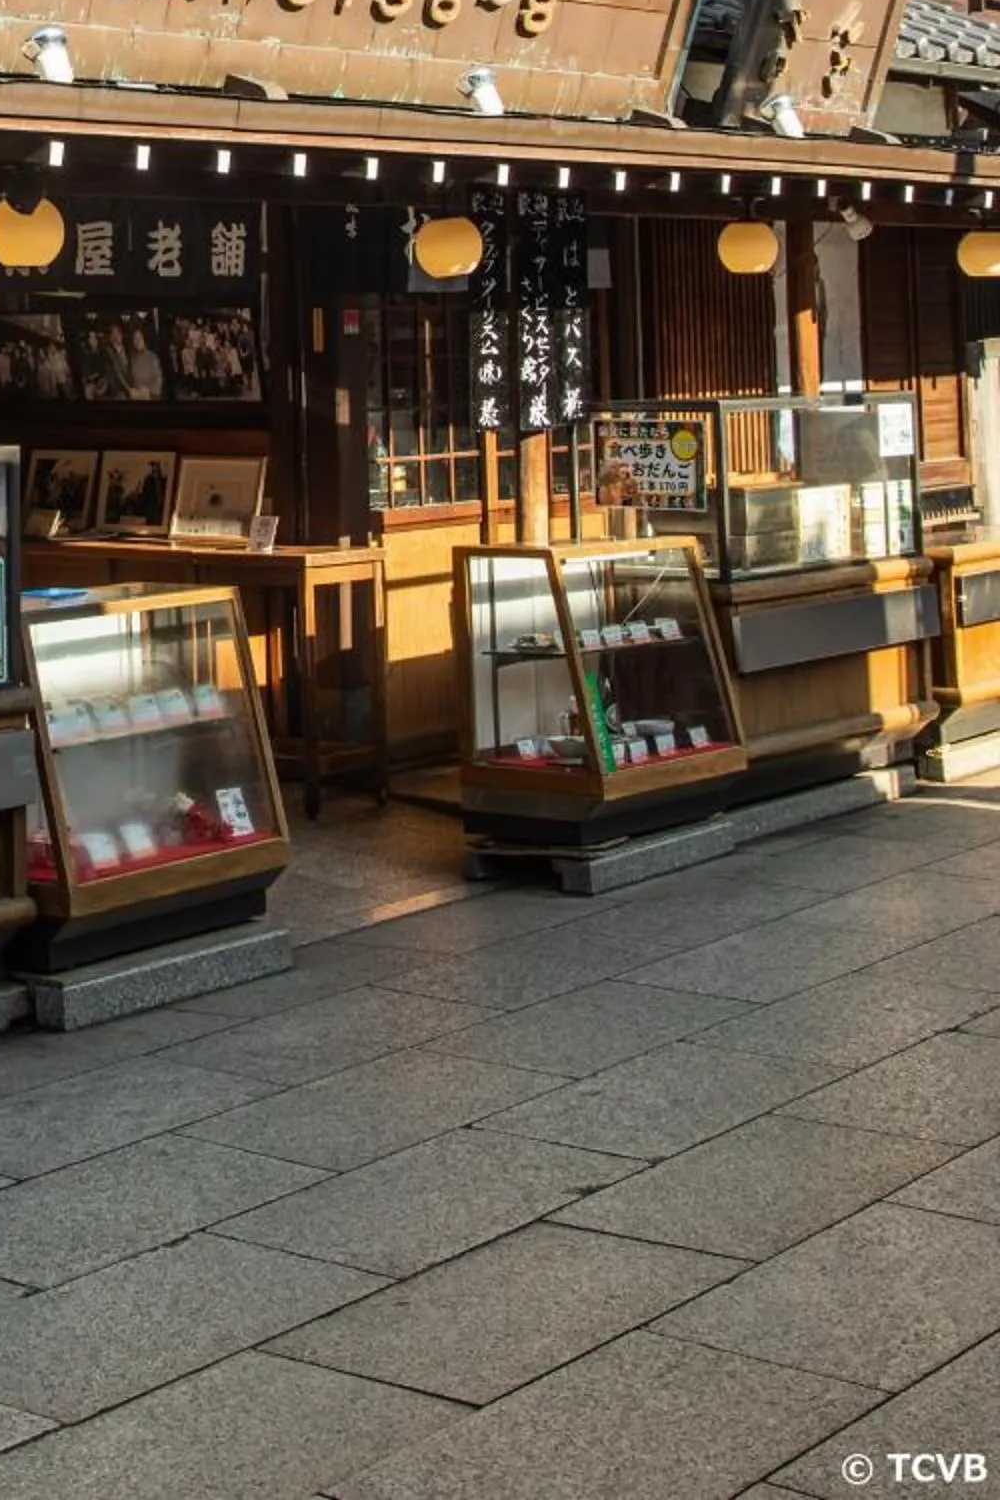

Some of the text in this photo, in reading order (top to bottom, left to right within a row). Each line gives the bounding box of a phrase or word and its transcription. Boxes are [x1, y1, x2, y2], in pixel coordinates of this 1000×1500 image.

[3, 218, 248, 279] 屋老舗
[631, 461, 693, 480] おだんご
